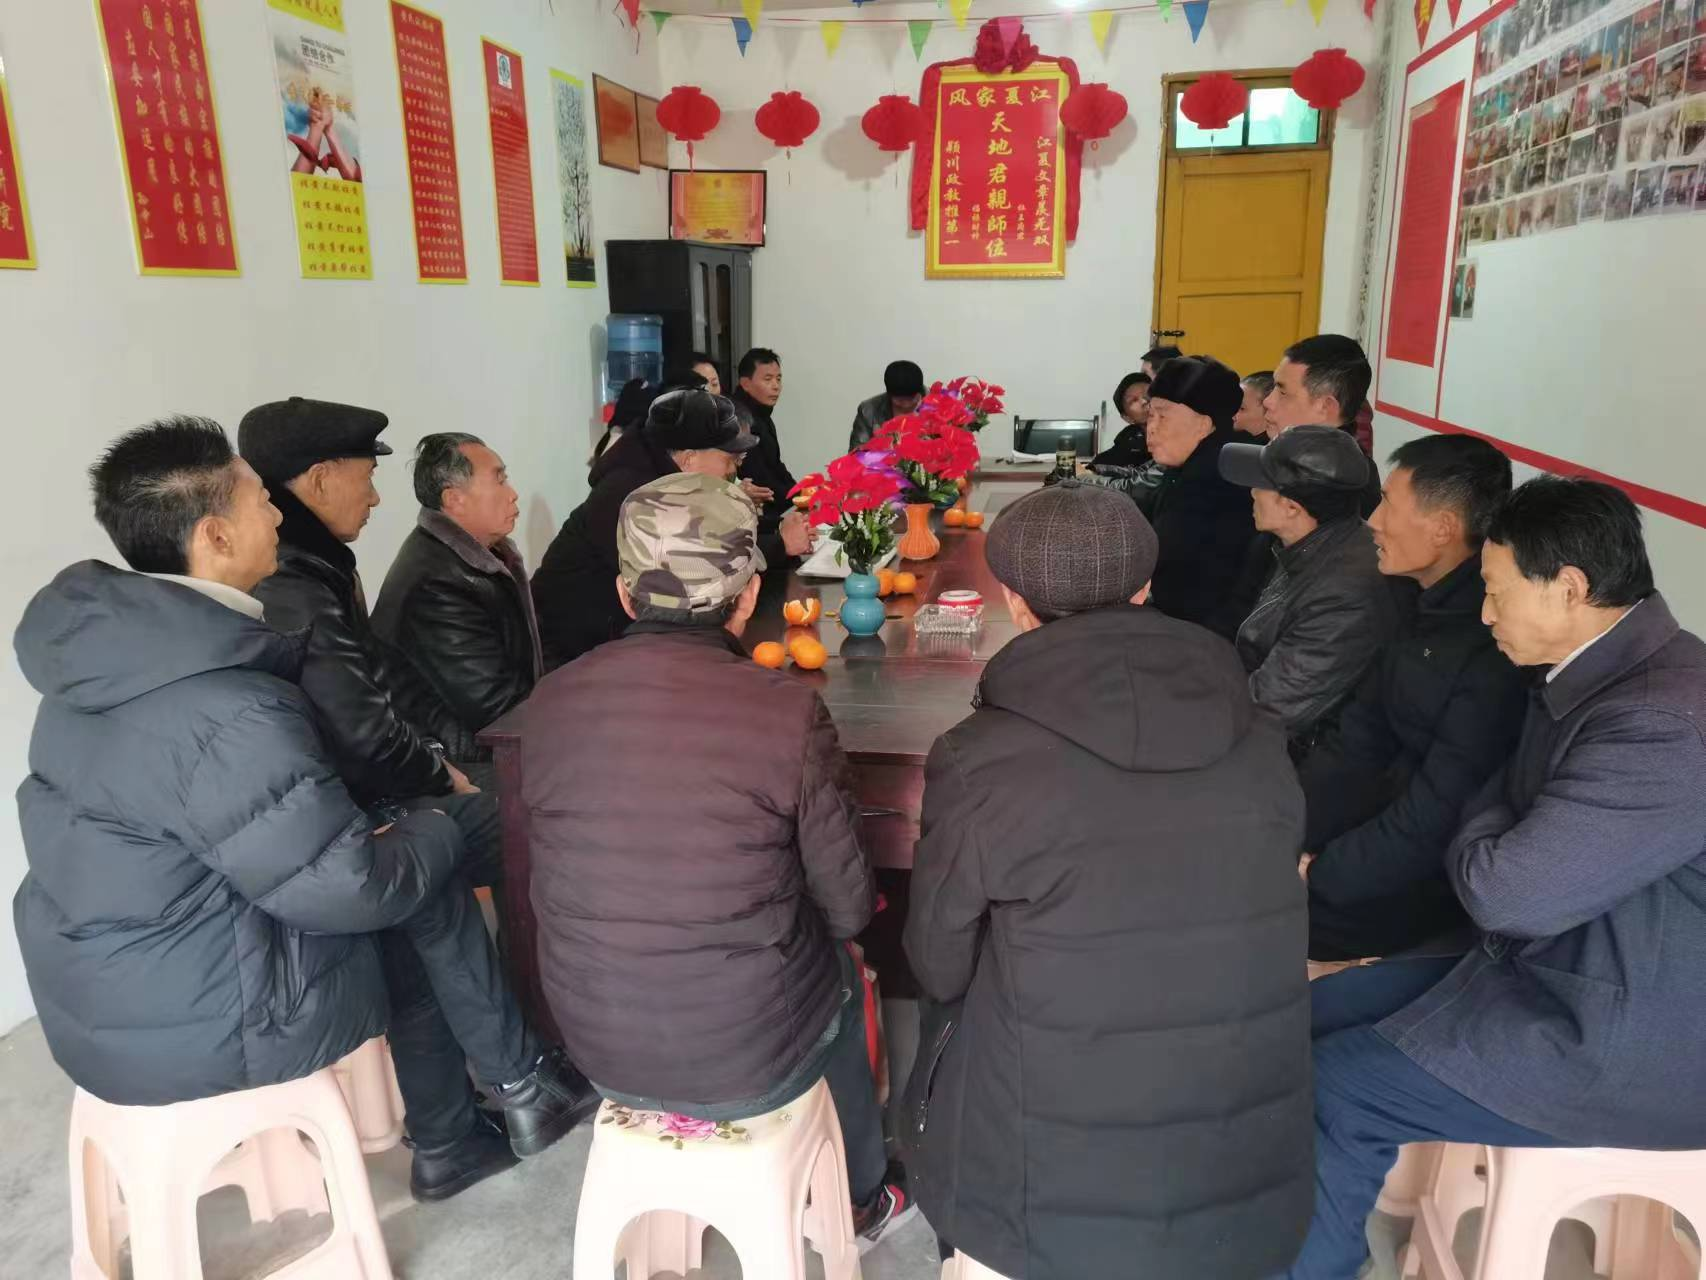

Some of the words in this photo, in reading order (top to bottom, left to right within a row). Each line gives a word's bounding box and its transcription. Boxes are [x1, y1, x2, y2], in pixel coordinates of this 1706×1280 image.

[948, 86, 1052, 108] 江夏家风
[985, 111, 1013, 258] 天地君親師位
